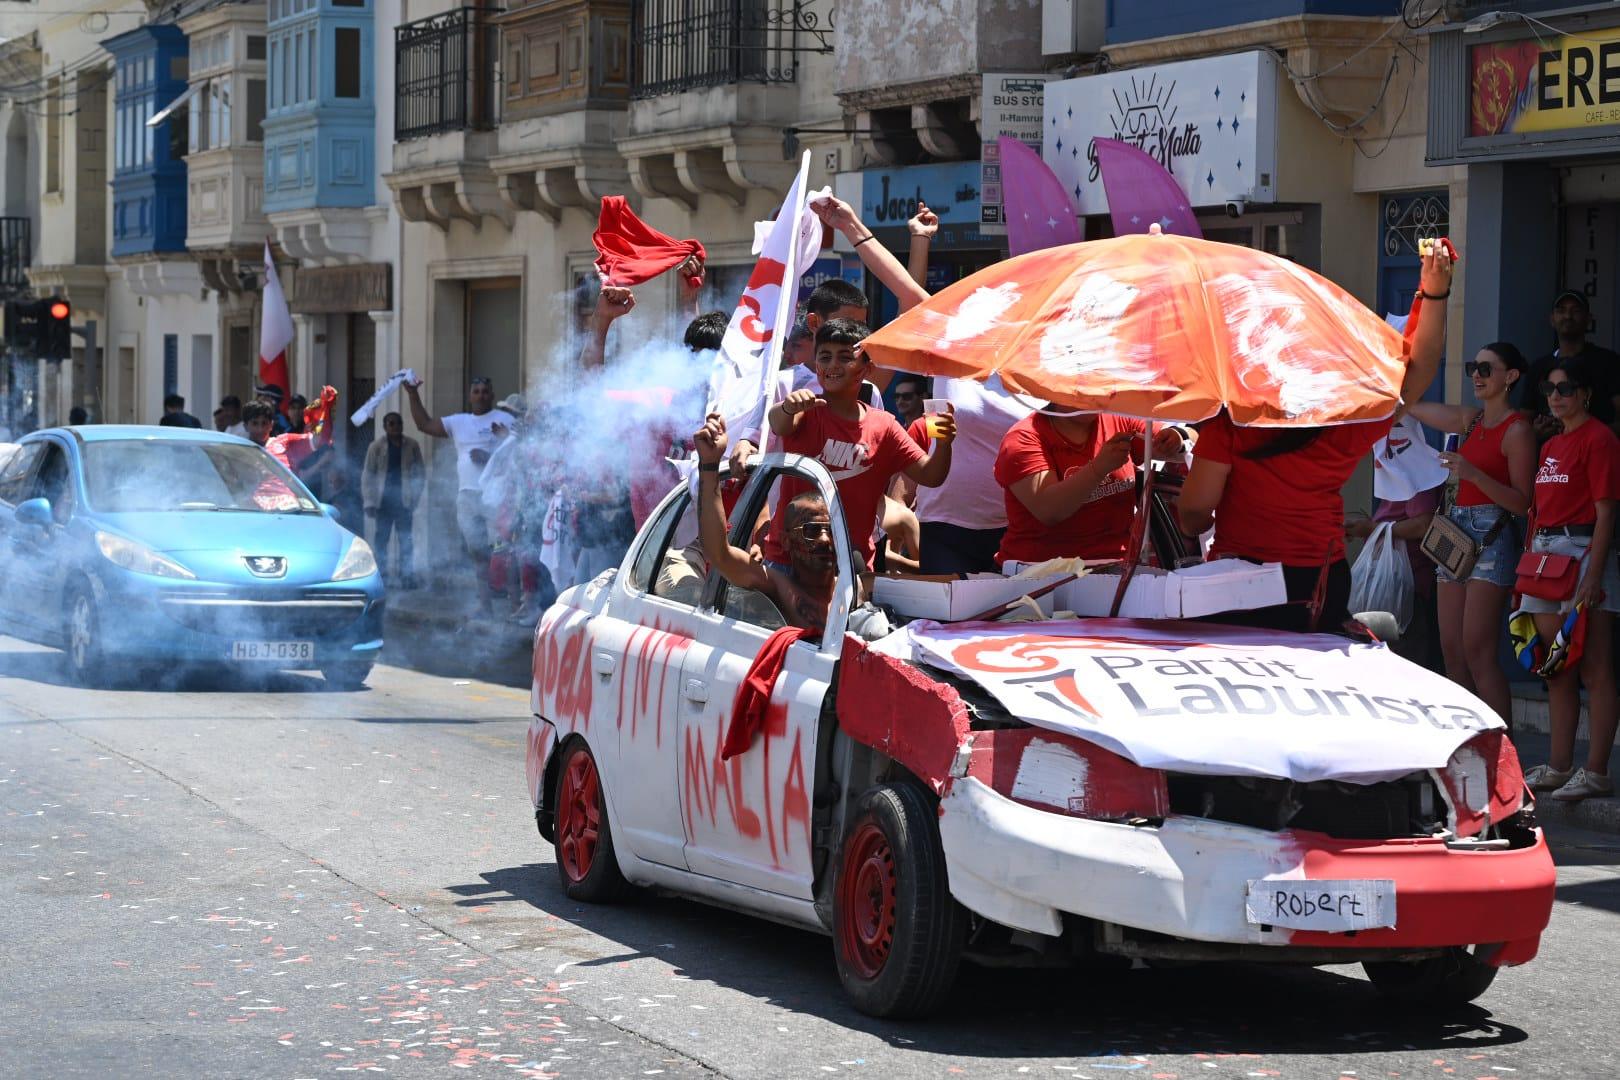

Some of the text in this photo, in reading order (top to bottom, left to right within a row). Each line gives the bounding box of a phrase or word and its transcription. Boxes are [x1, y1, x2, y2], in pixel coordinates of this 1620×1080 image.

[993, 95, 1044, 106] BUS STO
[1585, 110, 1605, 123] CAFE
[1149, 123, 1202, 174] Malta
[1090, 655, 1314, 680] Partit
[1117, 677, 1489, 733] Laburista
[1275, 891, 1364, 917] Robert
